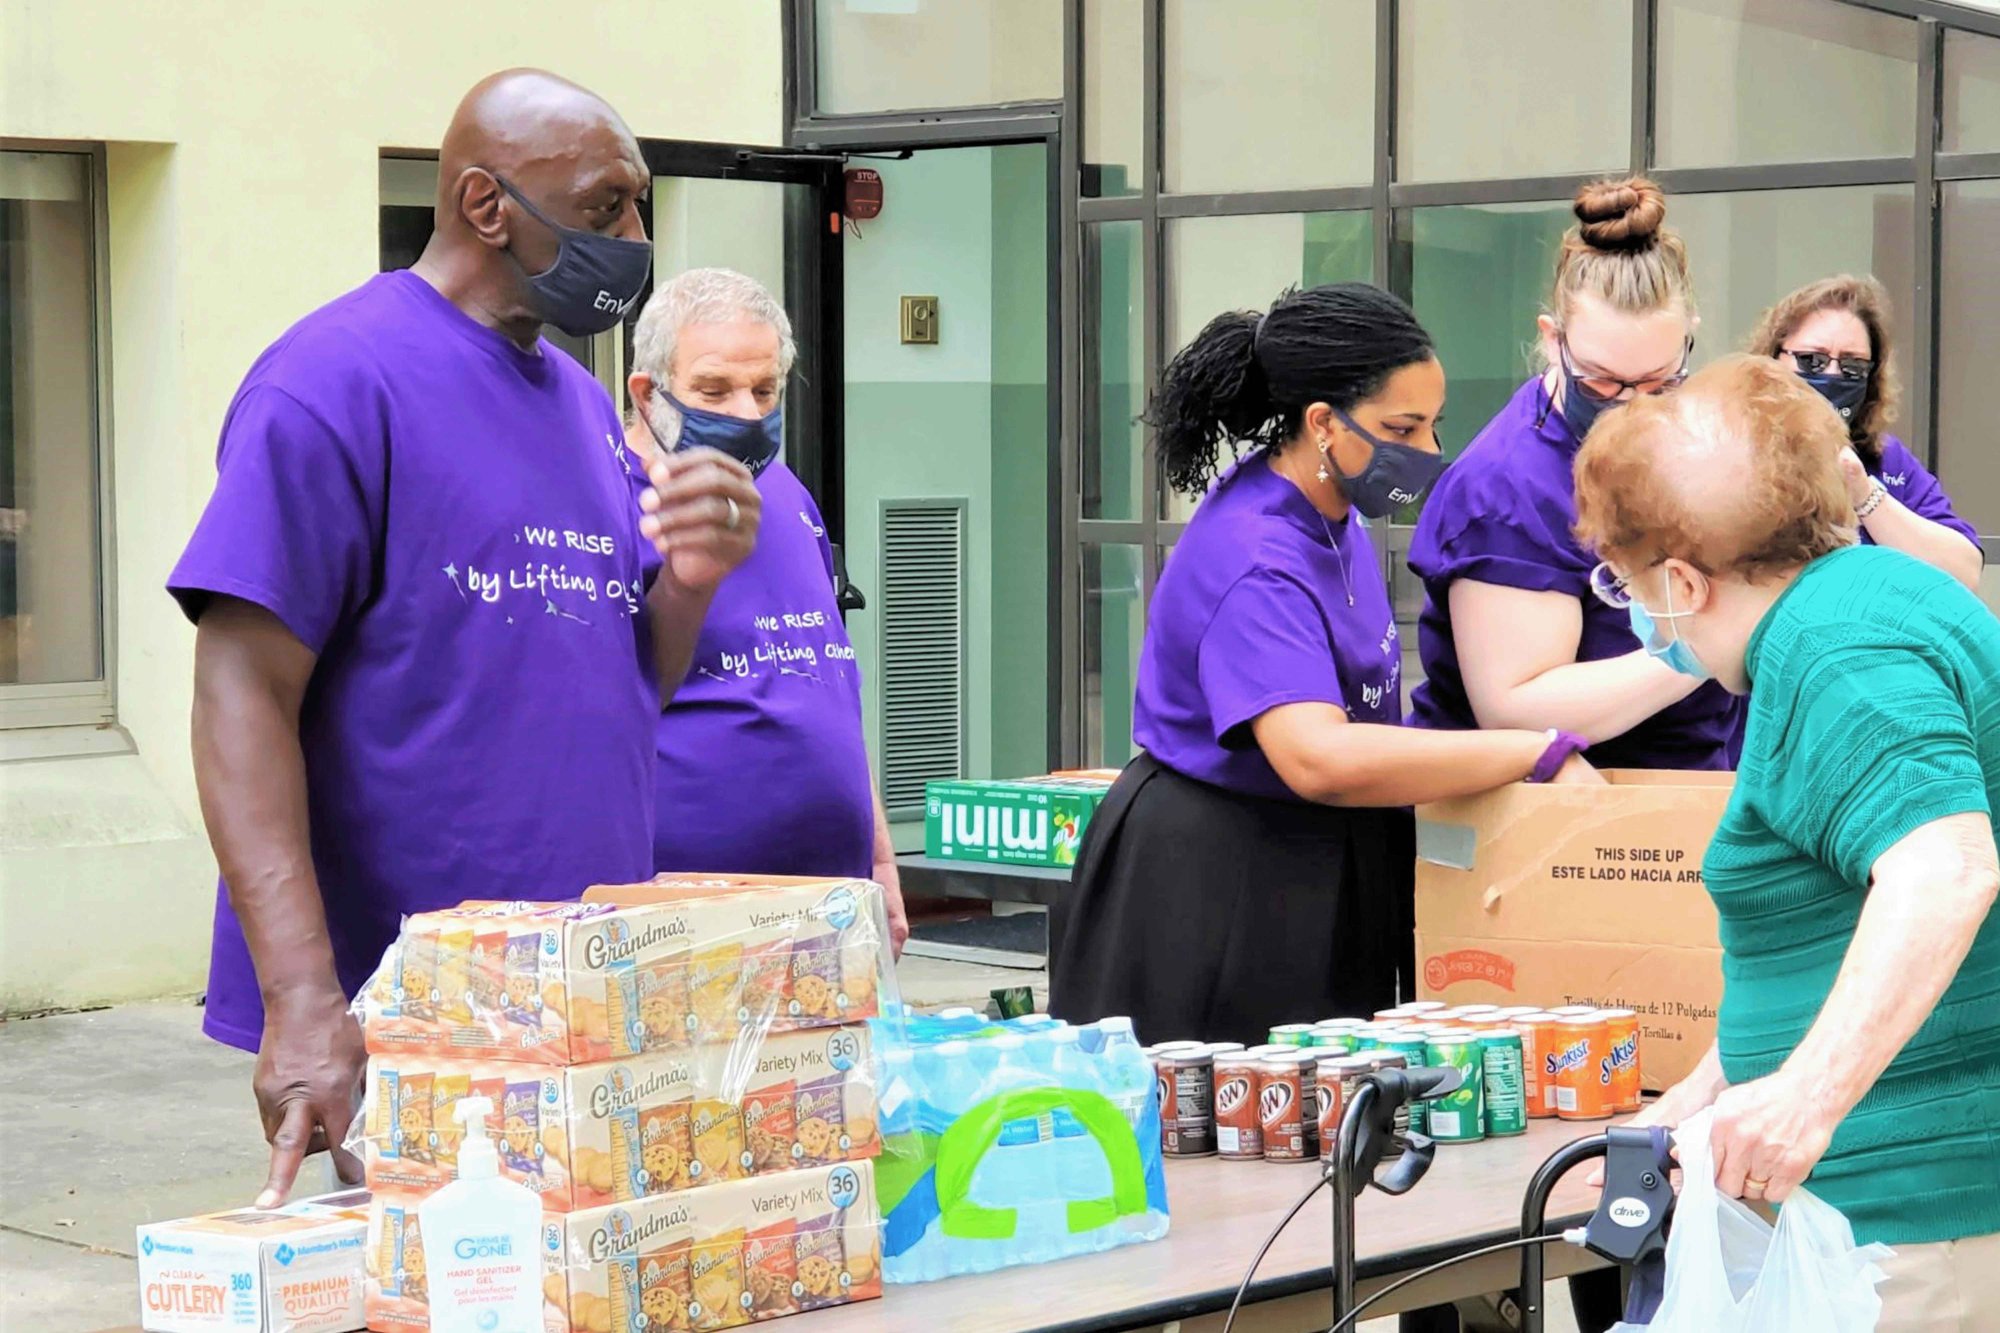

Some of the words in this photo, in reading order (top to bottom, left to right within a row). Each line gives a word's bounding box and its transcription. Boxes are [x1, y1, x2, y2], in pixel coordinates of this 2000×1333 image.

[857, 172, 877, 180] STOP
[524, 526, 557, 547] We
[563, 531, 614, 555] RISE
[468, 566, 499, 601] by
[509, 562, 597, 601] Lifting
[756, 616, 779, 630] We
[783, 611, 824, 628] RISE
[721, 651, 749, 677] by
[754, 641, 817, 668] Lifting
[1363, 683, 1382, 708] by
[942, 803, 1047, 858] mini
[1595, 848, 1626, 861] THIS
[1629, 848, 1660, 862] SIDE
[1666, 850, 1684, 862] UP
[1552, 866, 1585, 879] ESTE
[1590, 867, 1626, 881] LADO
[1631, 869, 1672, 882] HACIA
[546, 934, 555, 945] 36
[585, 917, 686, 969] Grandma's
[1648, 1001, 1659, 1014] de
[1662, 1002, 1673, 1016] 12
[1676, 1002, 1717, 1021] Pulgadas
[1642, 1026, 1674, 1039] Tortillas
[832, 1037, 853, 1058] 36
[1546, 1040, 1588, 1074] Sunkist
[1601, 1034, 1637, 1083] Snkist
[755, 1056, 797, 1073] Variety
[801, 1051, 823, 1068] Mix
[546, 1083, 555, 1094] 36
[590, 1063, 688, 1118] Grandma's
[832, 1174, 854, 1195] 36
[752, 1193, 797, 1212] Variety
[801, 1188, 823, 1205] Mix
[1614, 1206, 1645, 1218] drive
[298, 1241, 338, 1256] Member's
[339, 1234, 363, 1248] Mark
[548, 1229, 558, 1241] 36
[589, 1205, 688, 1263] Grandma's
[231, 1272, 253, 1292] 360
[447, 1269, 474, 1278] HAND
[476, 1264, 523, 1276] SANITIZER
[476, 1277, 493, 1285] GEL
[283, 1276, 350, 1298] PREMIUM
[146, 1283, 227, 1314] CUTLERY
[284, 1290, 350, 1315] QUALITY
